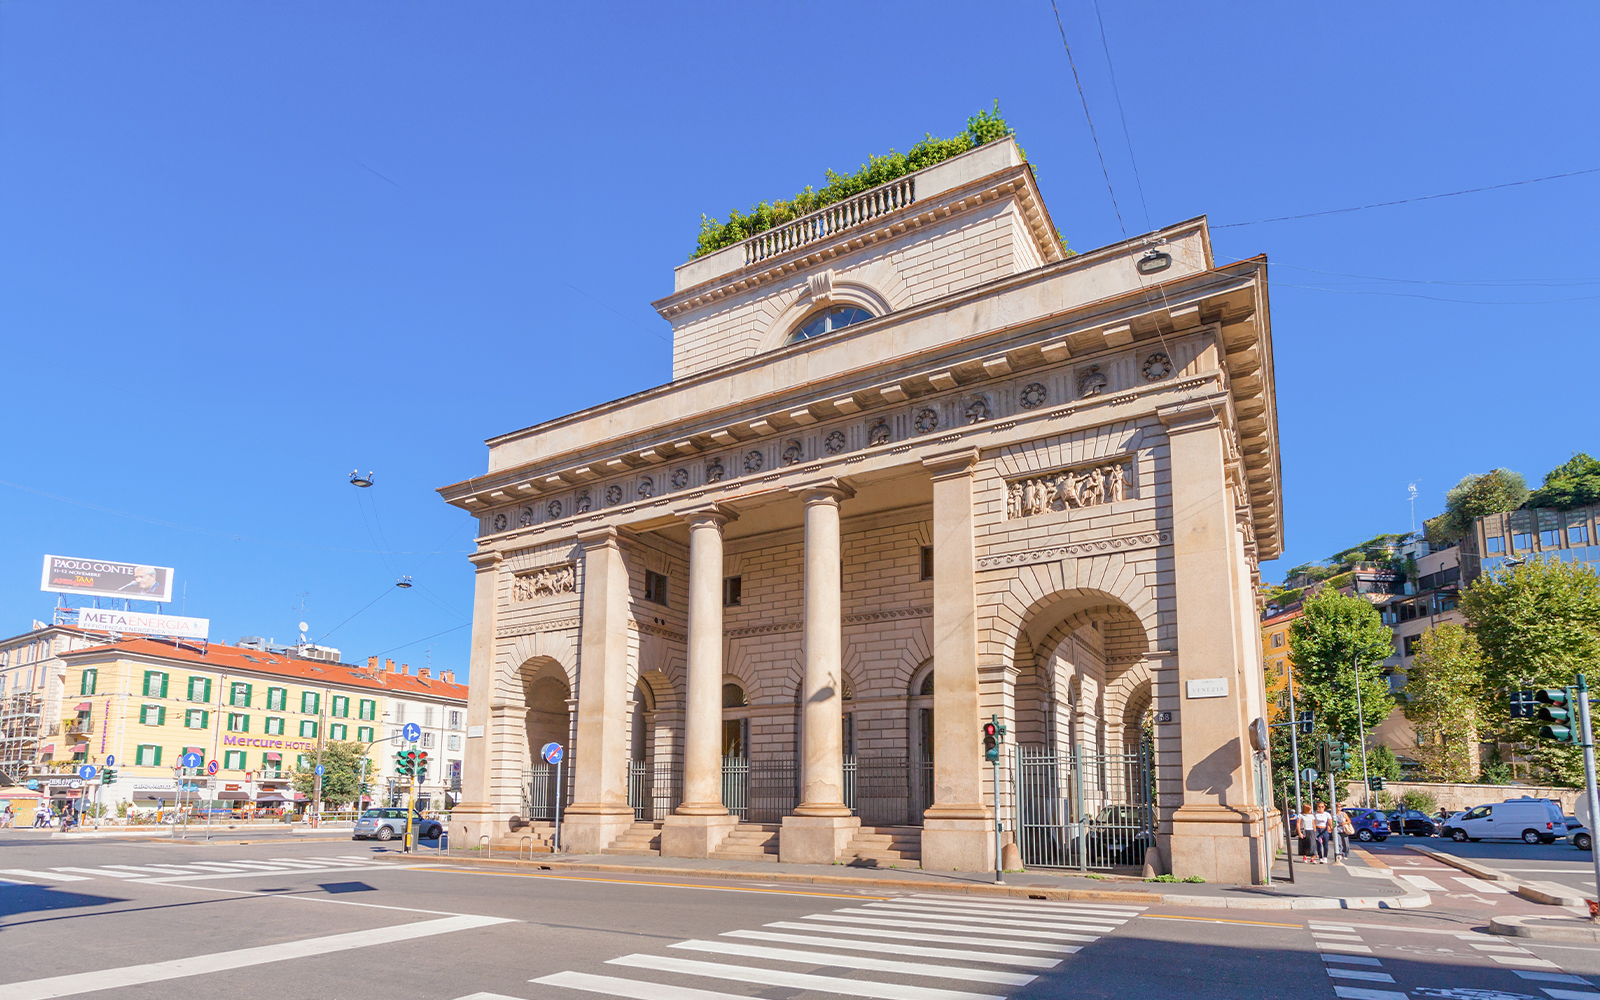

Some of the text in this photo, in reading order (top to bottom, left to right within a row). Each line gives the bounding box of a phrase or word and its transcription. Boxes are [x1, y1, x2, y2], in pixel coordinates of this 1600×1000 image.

[53, 559, 134, 576] PAOLO CONTE
[68, 570, 101, 578] NOVEMBRE
[75, 575, 94, 584] TAM
[83, 622, 123, 631] EFFICIENZA
[124, 626, 166, 635] ENERGETICA
[84, 612, 190, 631] METAENERGIA
[223, 734, 316, 751] Mercure HOTEL
